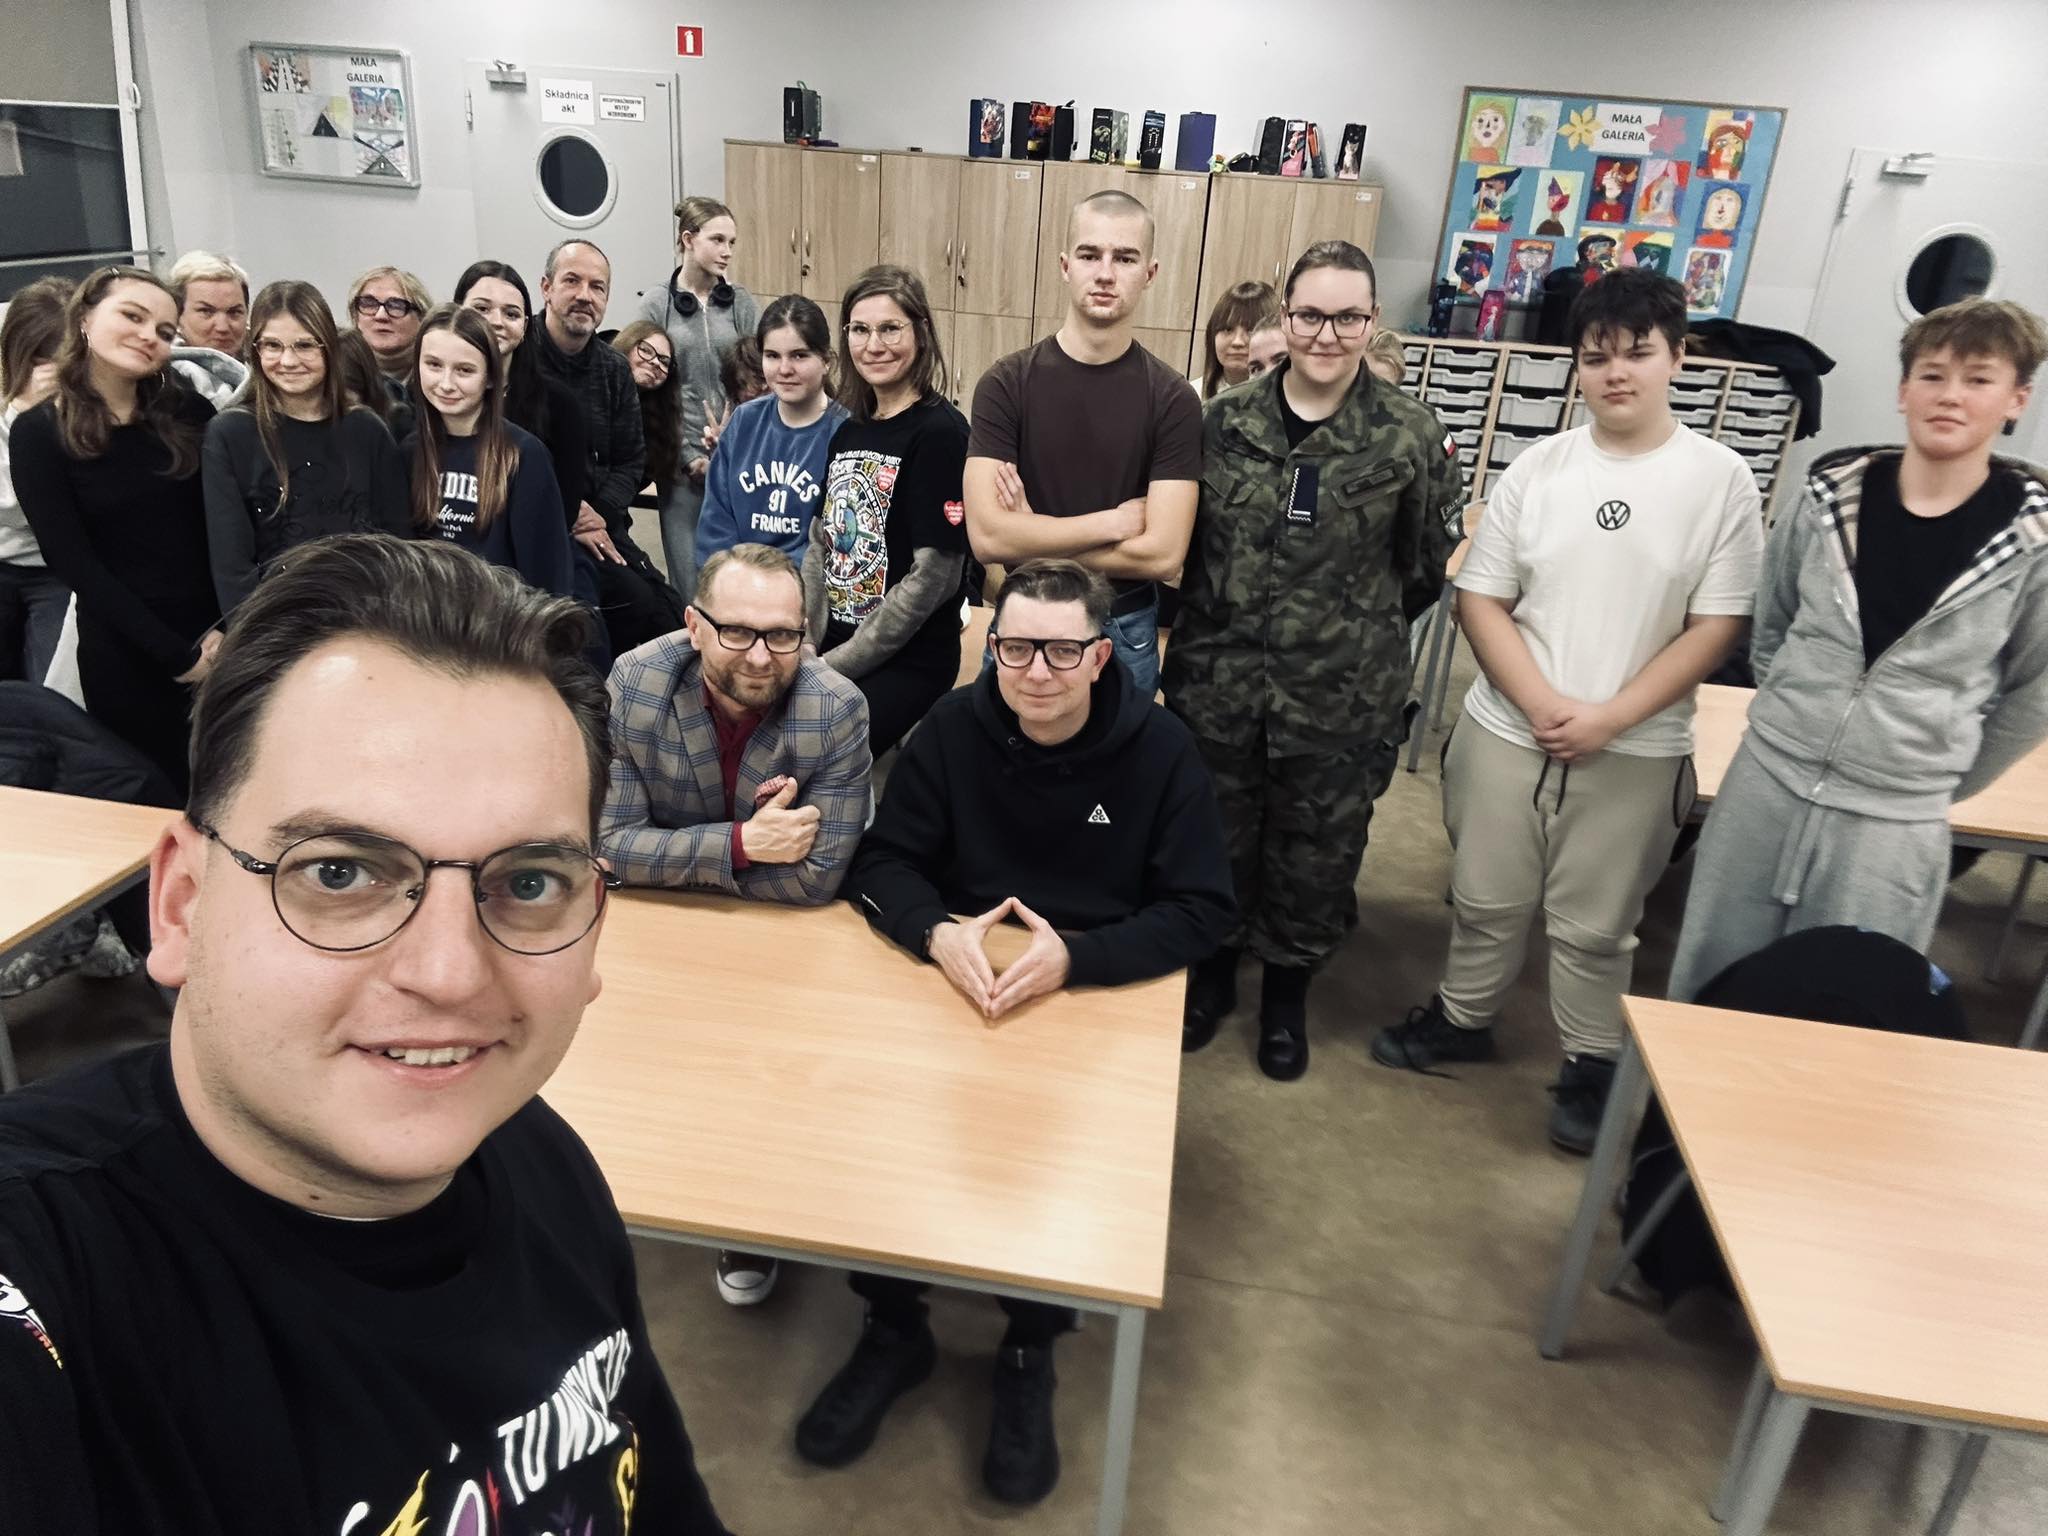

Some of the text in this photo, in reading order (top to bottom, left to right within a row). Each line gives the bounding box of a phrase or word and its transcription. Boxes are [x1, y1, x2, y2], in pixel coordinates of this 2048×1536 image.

[350, 57, 377, 67] MAŁA
[346, 73, 384, 83] GALERIA
[545, 89, 589, 100] Składnica
[561, 104, 575, 113] akt
[1611, 113, 1642, 124] MAŁA
[1601, 130, 1645, 141] GALERIA
[739, 460, 820, 502] CANNES
[768, 489, 787, 514] 91
[751, 513, 800, 534] FRANCE
